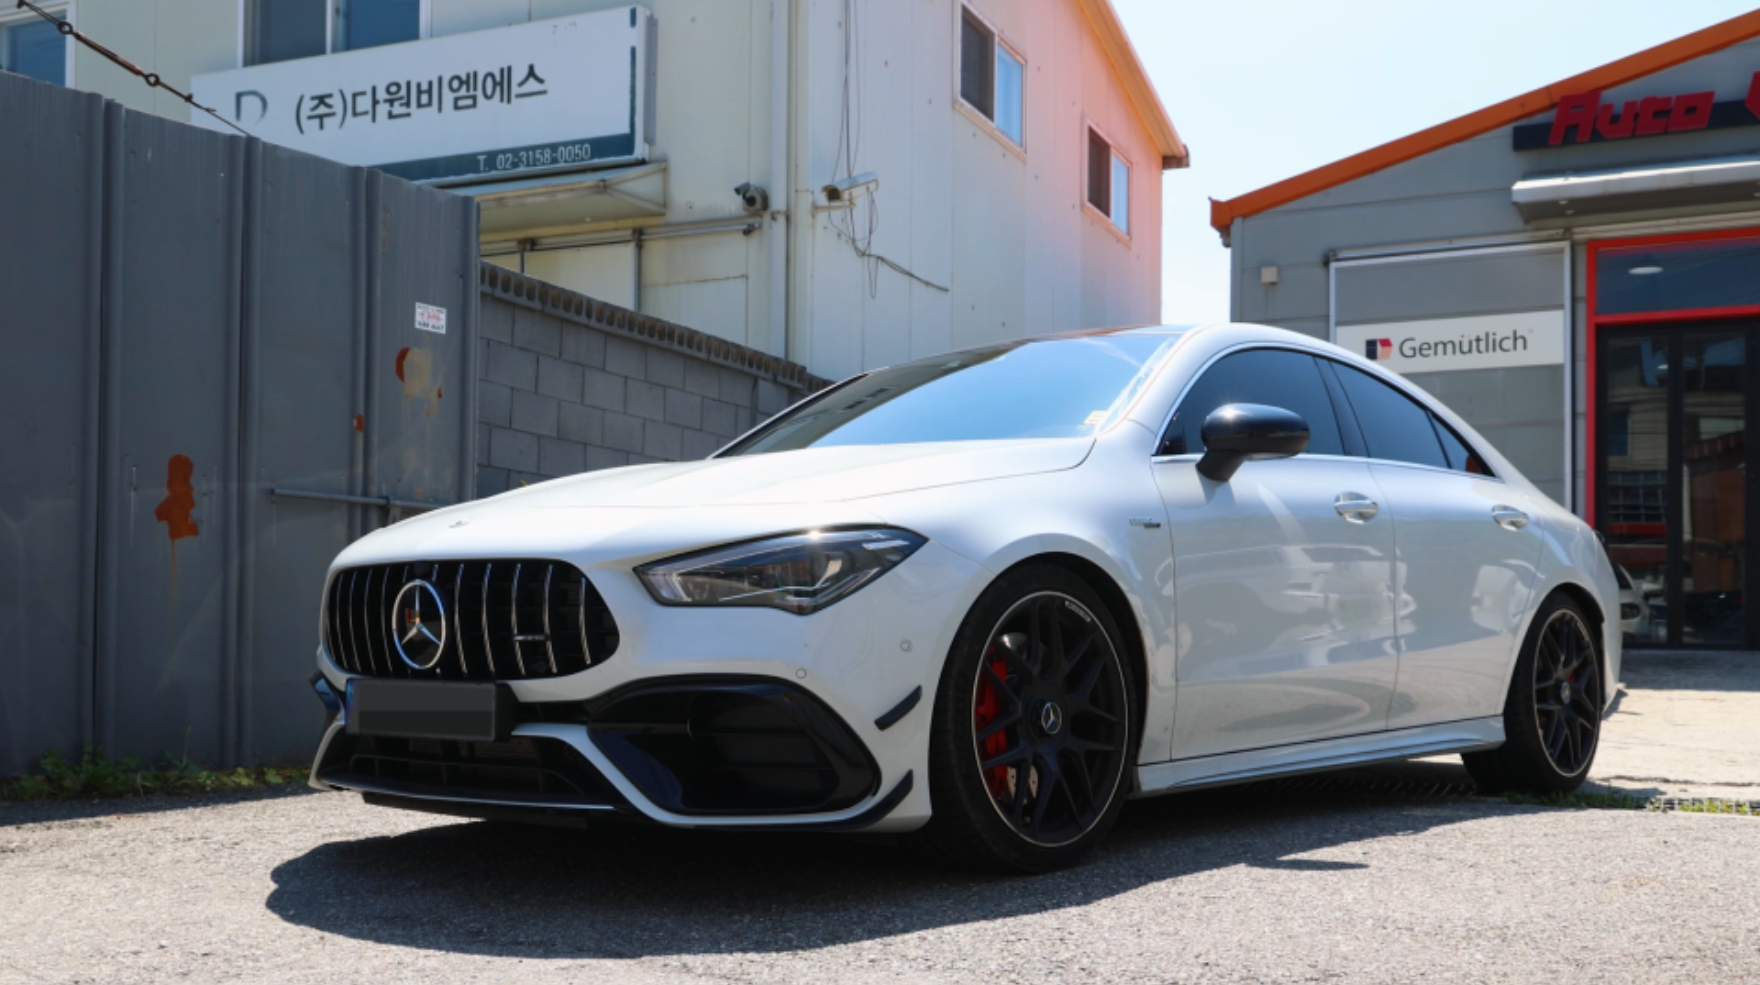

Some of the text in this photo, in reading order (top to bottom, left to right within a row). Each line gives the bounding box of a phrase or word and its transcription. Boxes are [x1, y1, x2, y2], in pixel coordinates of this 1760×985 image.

[295, 63, 548, 135] (주)다원비엠에스
[496, 143, 591, 170] 02-3158-0050
[1398, 329, 1528, 359] Gemütlich
